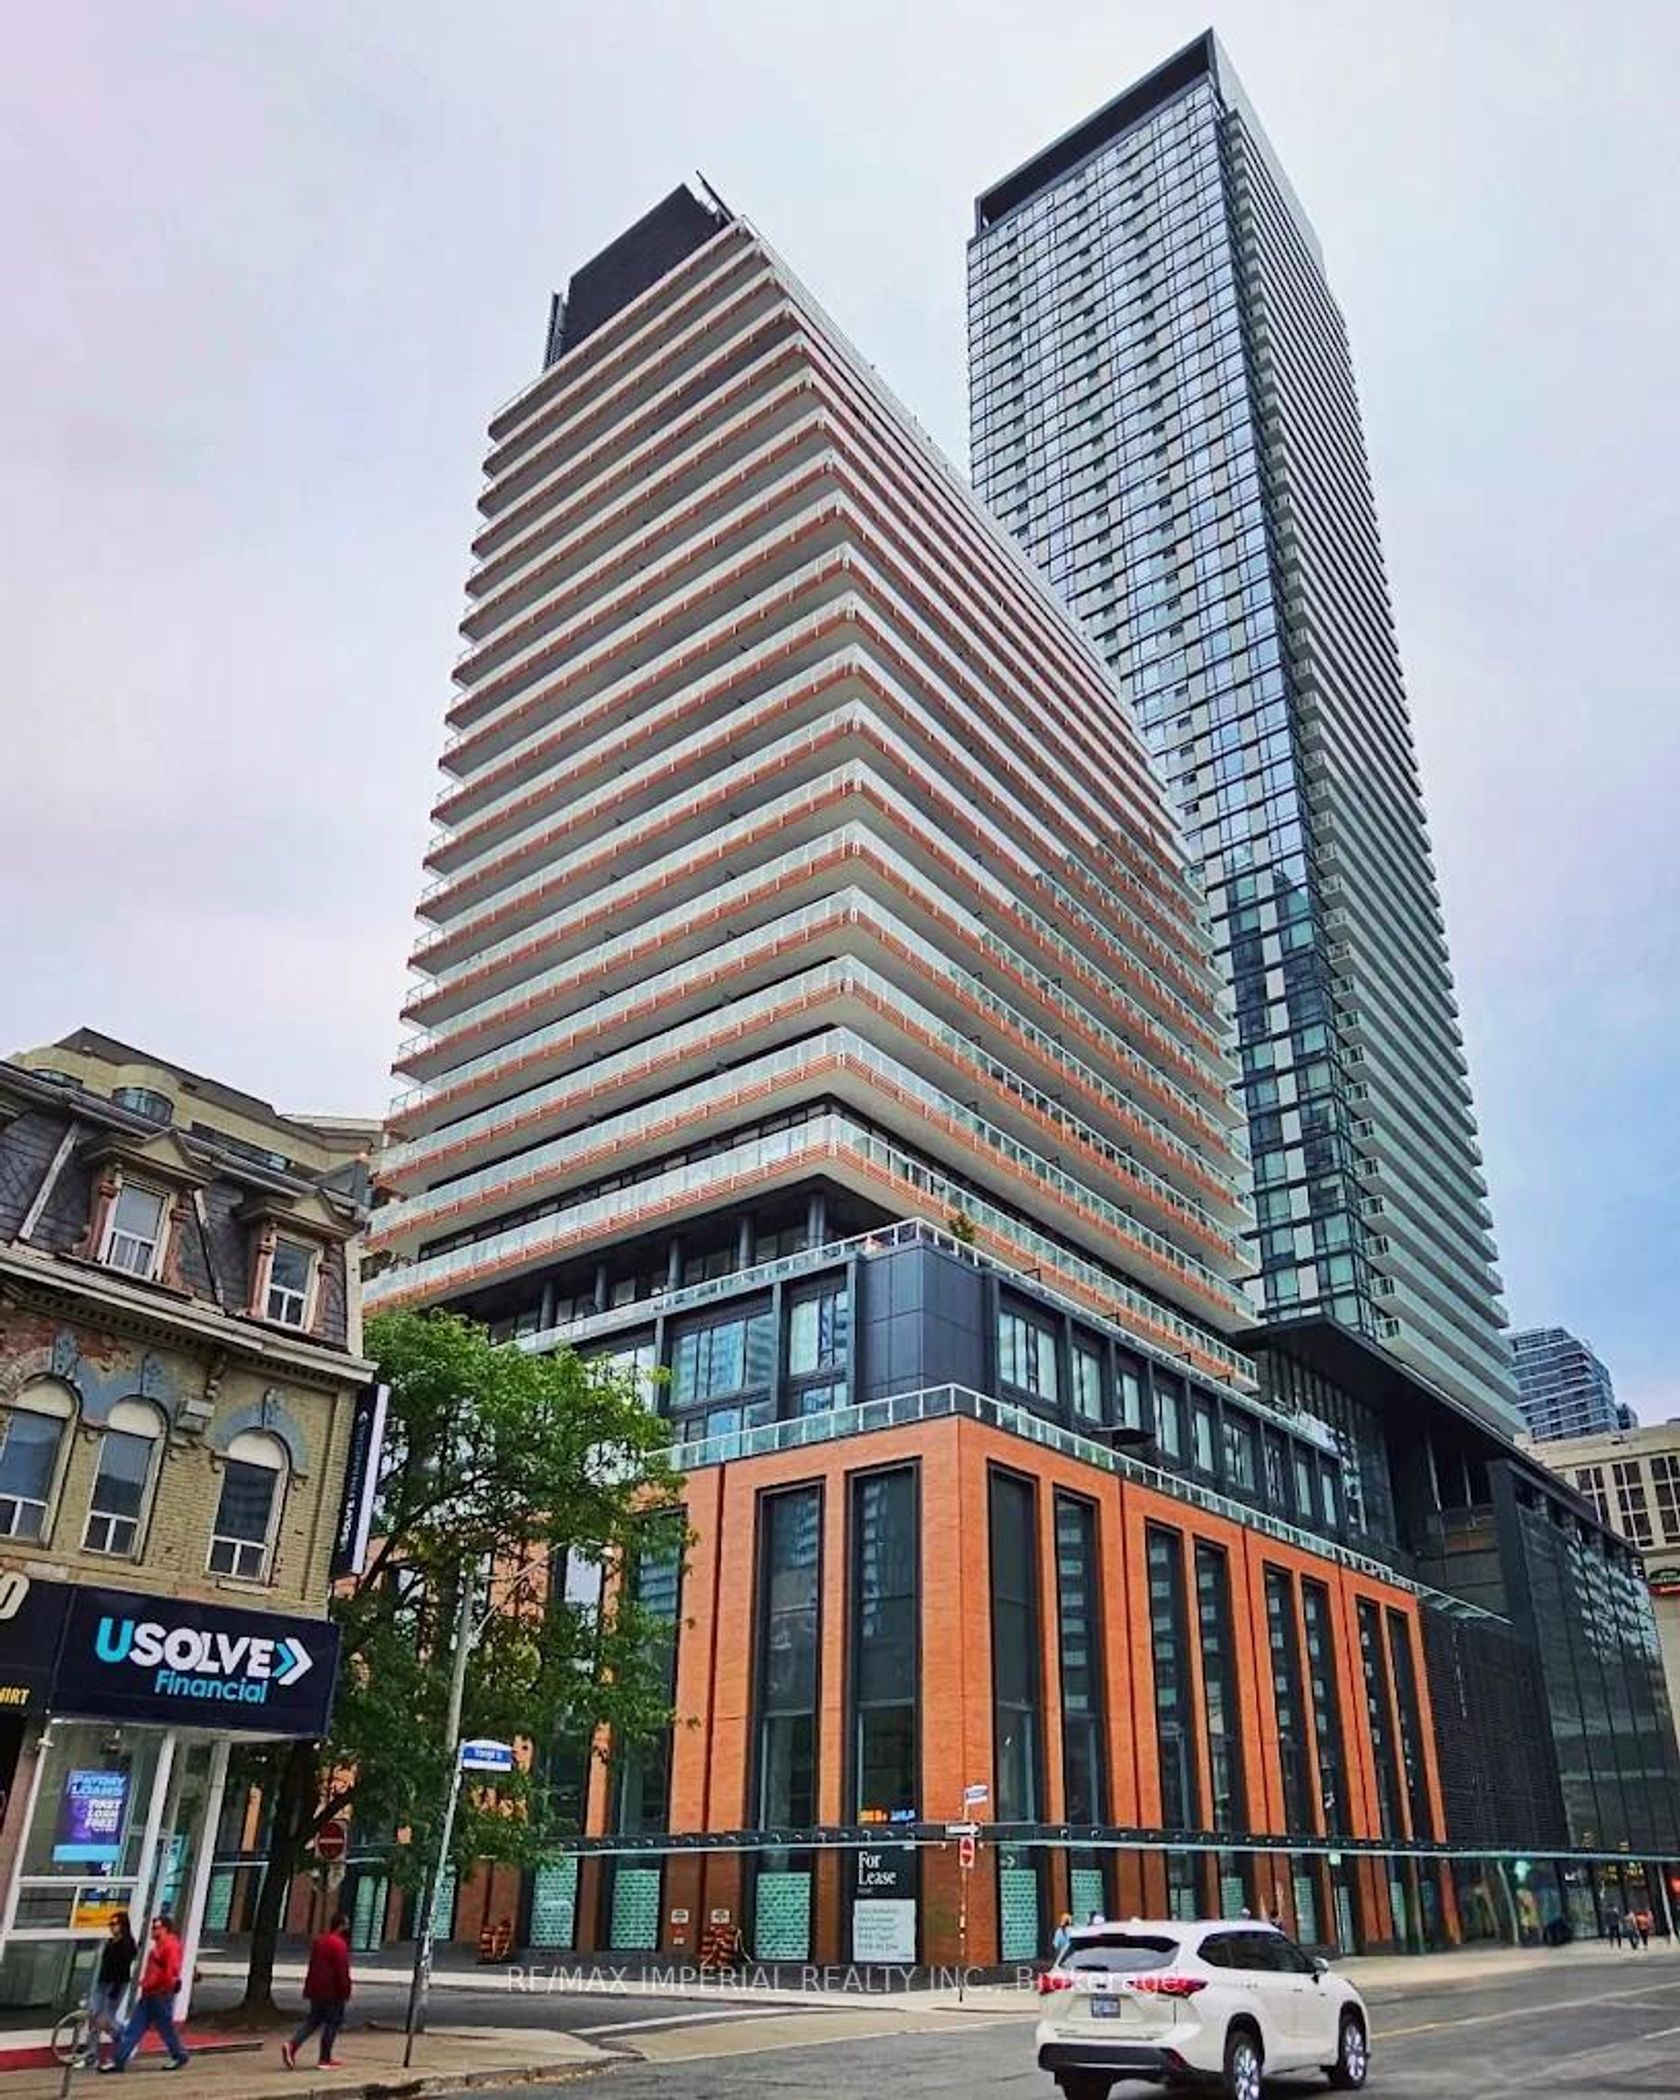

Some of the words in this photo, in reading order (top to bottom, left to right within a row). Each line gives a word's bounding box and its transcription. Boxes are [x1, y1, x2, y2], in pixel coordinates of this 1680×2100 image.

[95, 1617, 275, 1678] USOLVE
[154, 1670, 269, 1703] Financial
[858, 1851, 881, 1869] For
[858, 1868, 897, 1886] Lease
